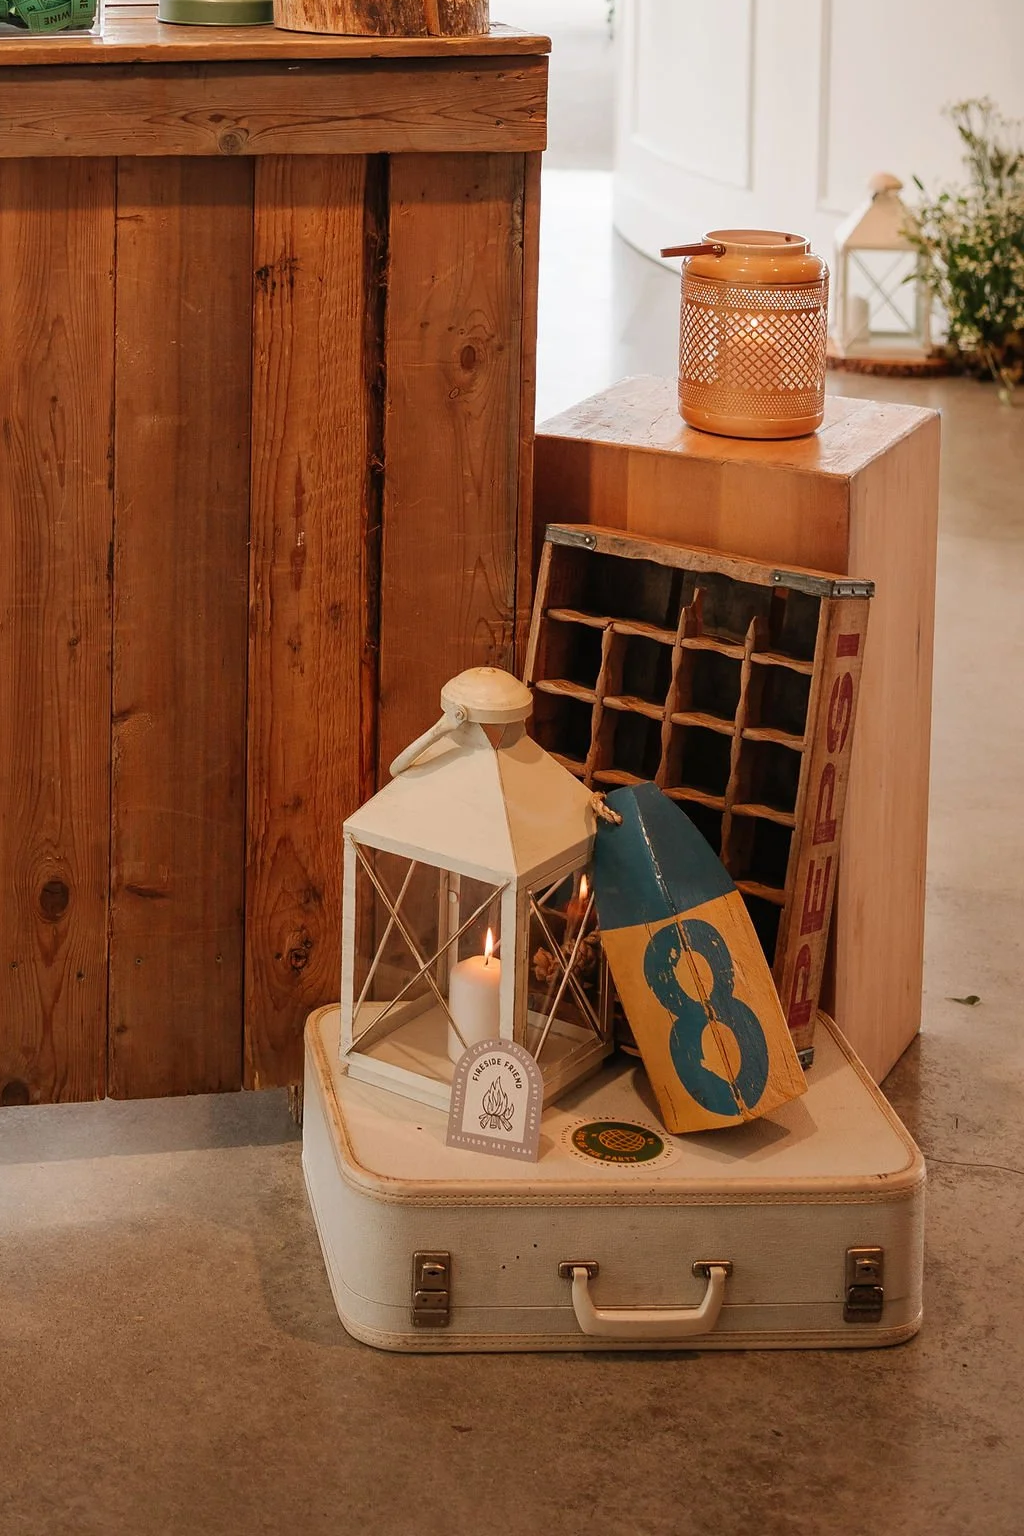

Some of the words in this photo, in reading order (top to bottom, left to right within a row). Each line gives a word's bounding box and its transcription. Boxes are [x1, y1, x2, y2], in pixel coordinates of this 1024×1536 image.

[43, 10, 71, 25] WINE
[788, 633, 861, 1029] PEPSI
[472, 1058, 502, 1082] FIRESIDE
[503, 1061, 523, 1089] FRIEND
[643, 918, 769, 1116] 8
